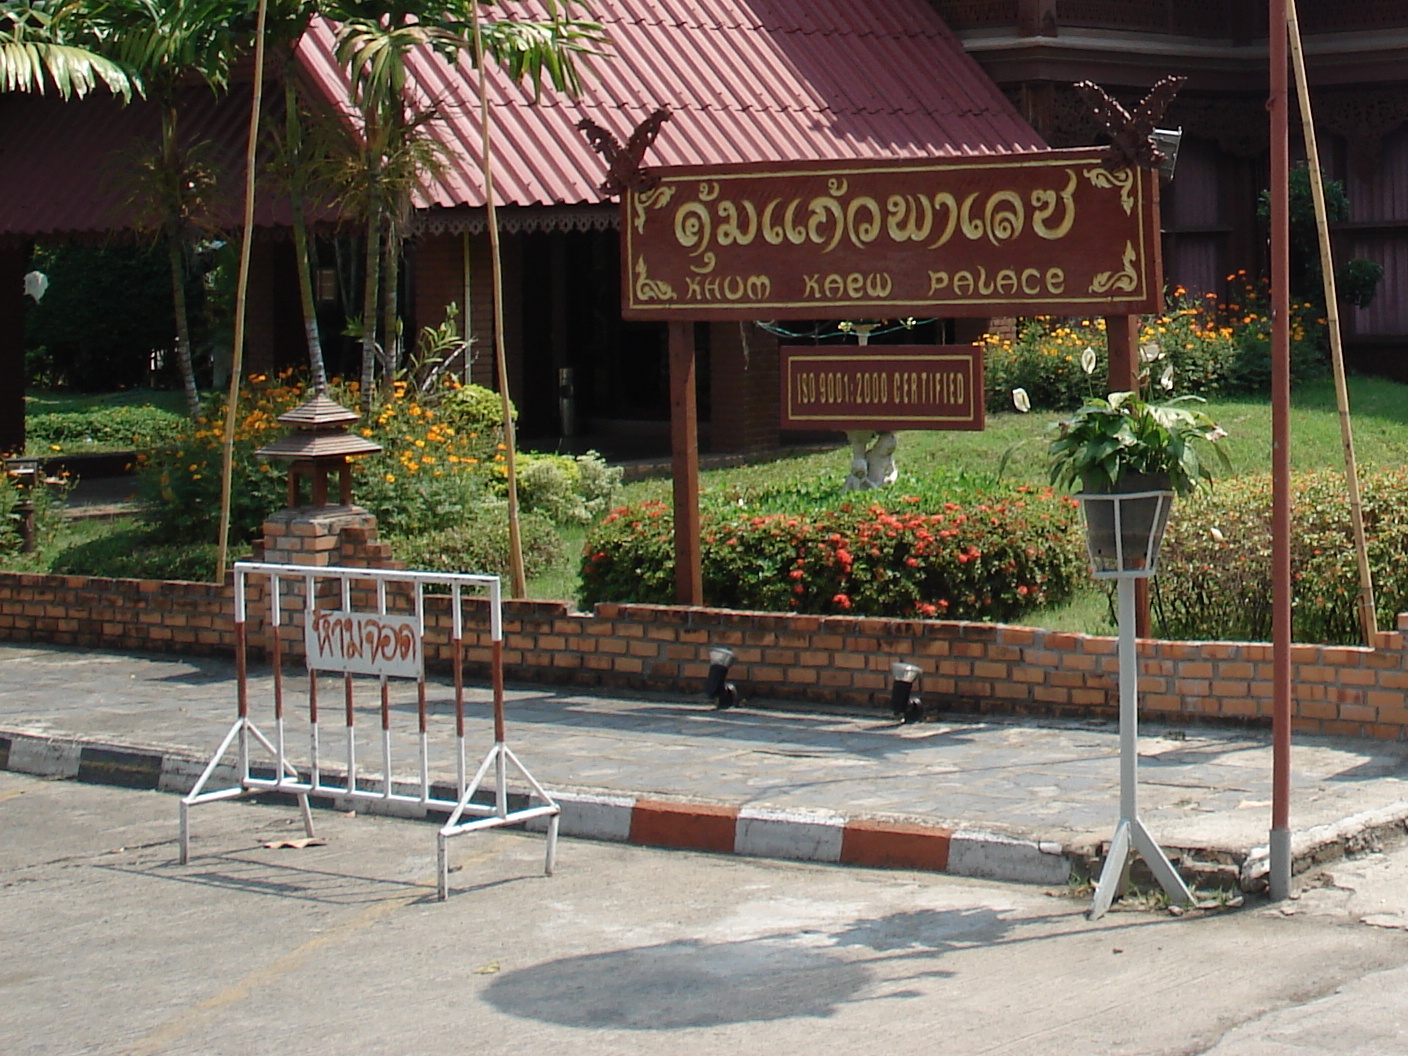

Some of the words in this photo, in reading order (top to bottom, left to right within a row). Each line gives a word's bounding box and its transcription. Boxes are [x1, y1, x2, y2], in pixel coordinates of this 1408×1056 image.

[686, 274, 771, 300] KHUM
[797, 373, 815, 404] ISO
[819, 372, 888, 404] 9001:2000
[893, 372, 964, 405] CERTIFIED
[312, 609, 417, 665] ห้ามจอด
